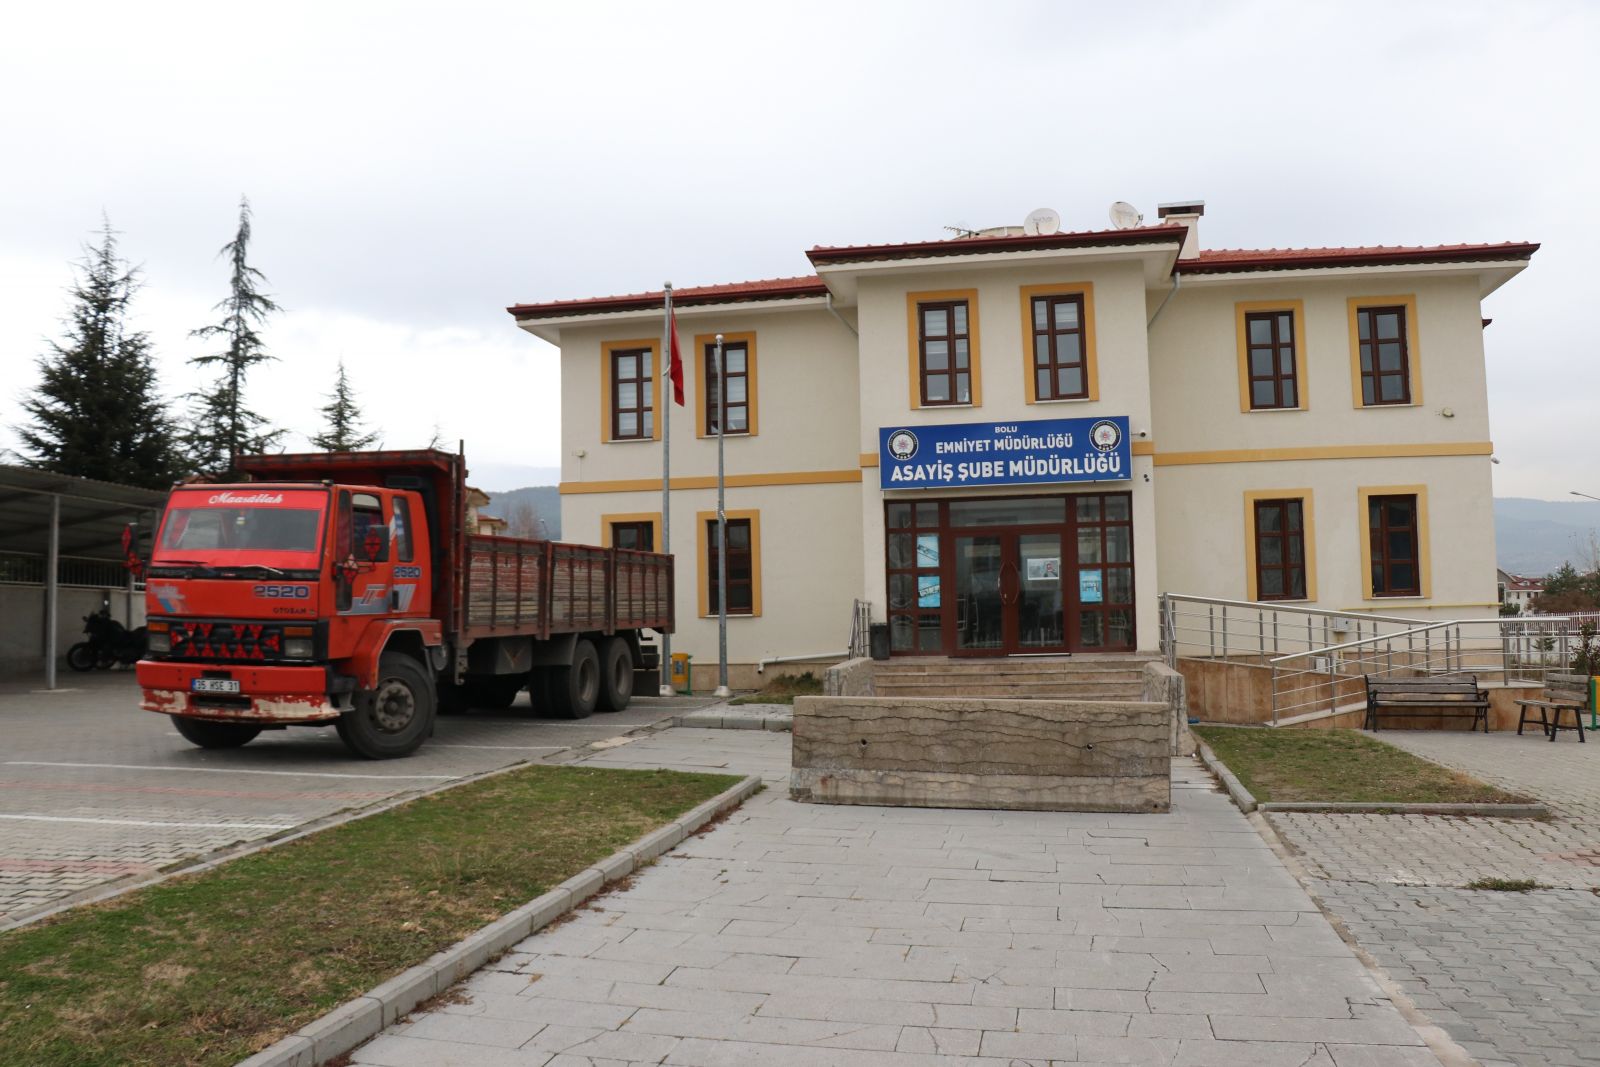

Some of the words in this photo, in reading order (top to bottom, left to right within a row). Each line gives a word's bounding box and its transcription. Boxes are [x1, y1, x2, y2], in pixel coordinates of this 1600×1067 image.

[936, 438, 991, 454] EMNİYET
[994, 433, 1073, 450] MÜDÜRLÜĞÜ
[891, 460, 954, 482] ASAYİŞ
[958, 461, 1005, 481] ŞUBE
[1009, 452, 1121, 477] MÜDÜRLÜĞÜ
[393, 566, 422, 579] 2520
[253, 585, 310, 599] 2520
